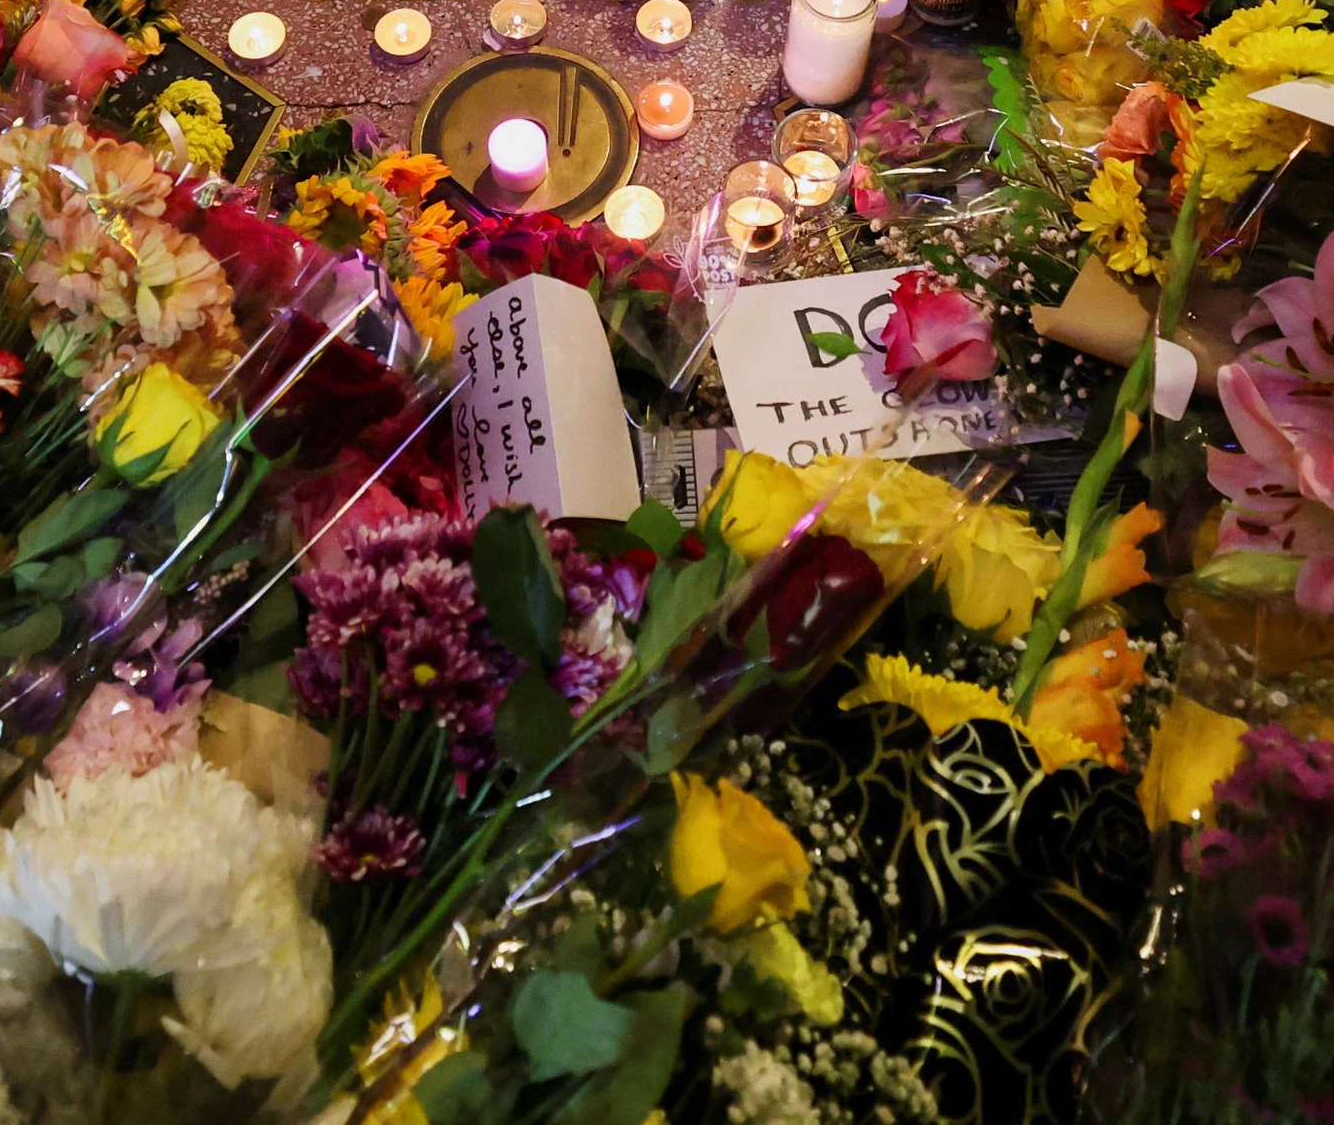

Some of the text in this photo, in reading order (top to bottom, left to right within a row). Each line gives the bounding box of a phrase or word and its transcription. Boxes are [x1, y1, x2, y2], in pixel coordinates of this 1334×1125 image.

[508, 296, 547, 455] above all
[755, 395, 853, 424] THE
[471, 404, 491, 484] love
[500, 423, 523, 494] wish
